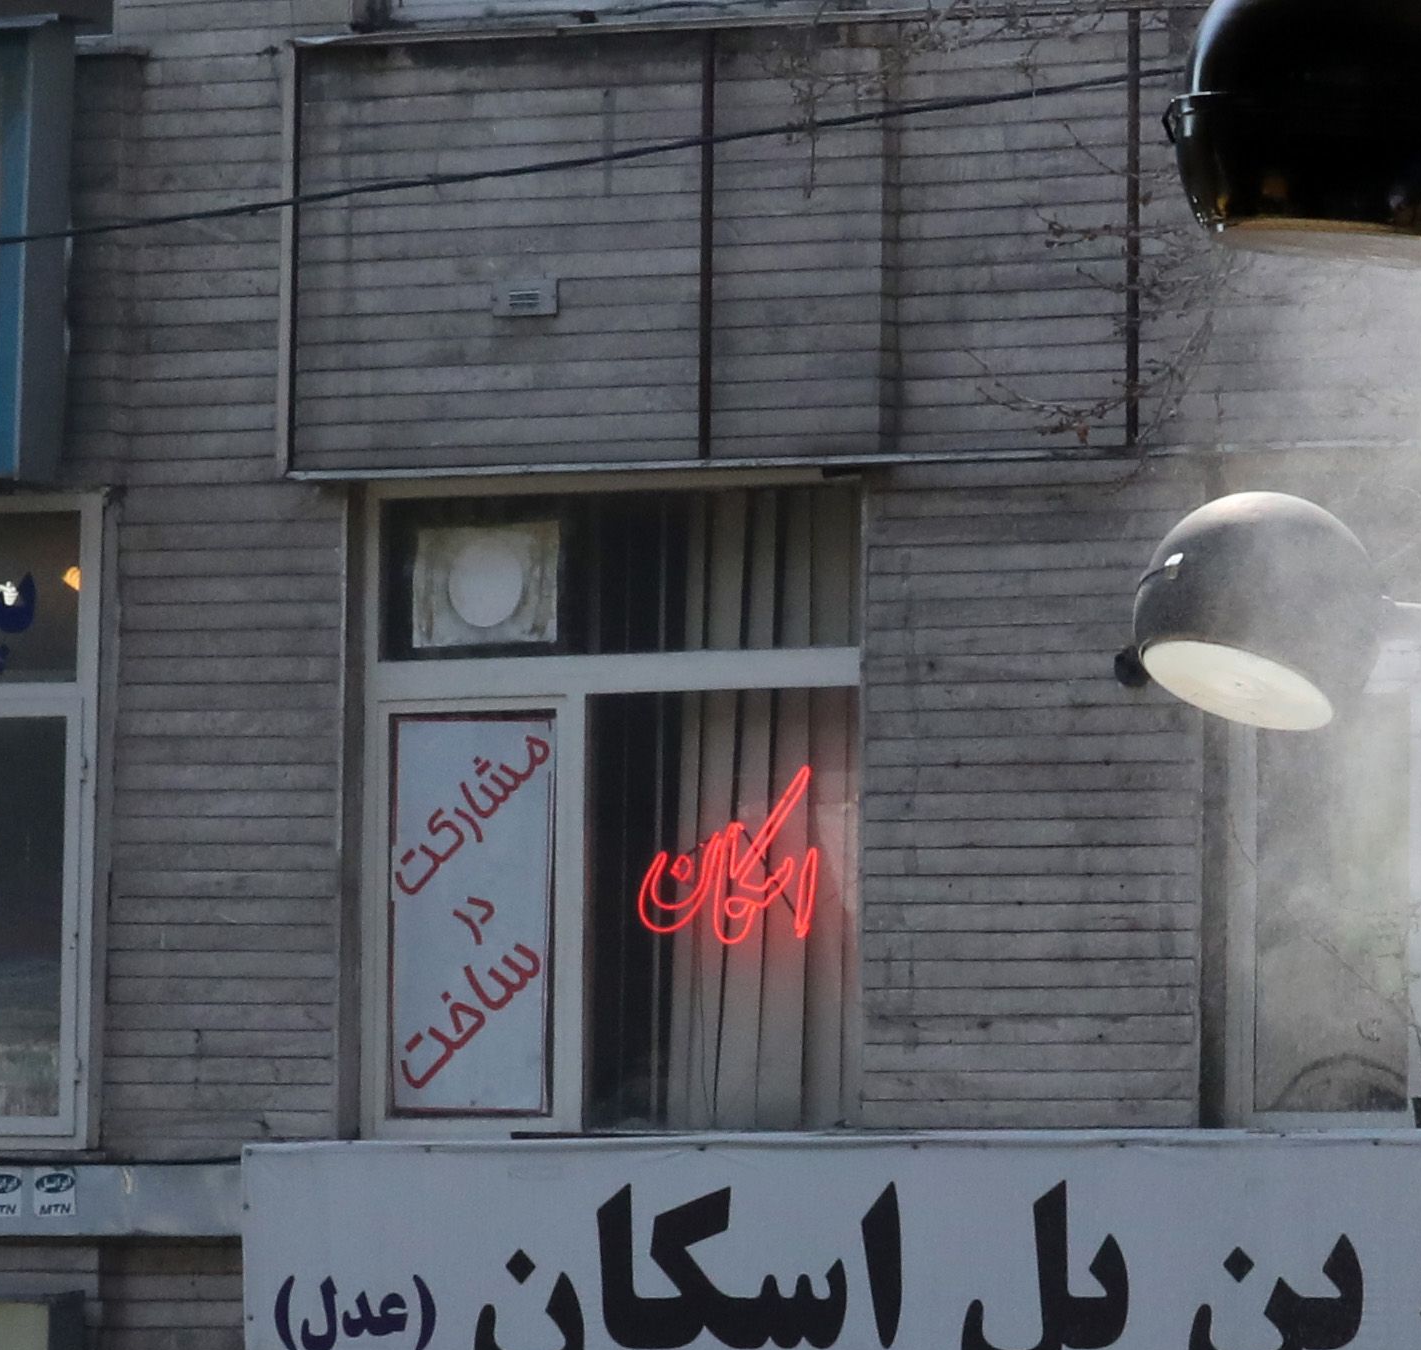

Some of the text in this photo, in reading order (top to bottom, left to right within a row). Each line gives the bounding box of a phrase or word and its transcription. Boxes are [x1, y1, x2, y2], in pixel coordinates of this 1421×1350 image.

[393, 732, 552, 896] مشارکت
[452, 895, 496, 946] در
[399, 941, 542, 1091] ساخت
[38, 1203, 71, 1216] MTN
